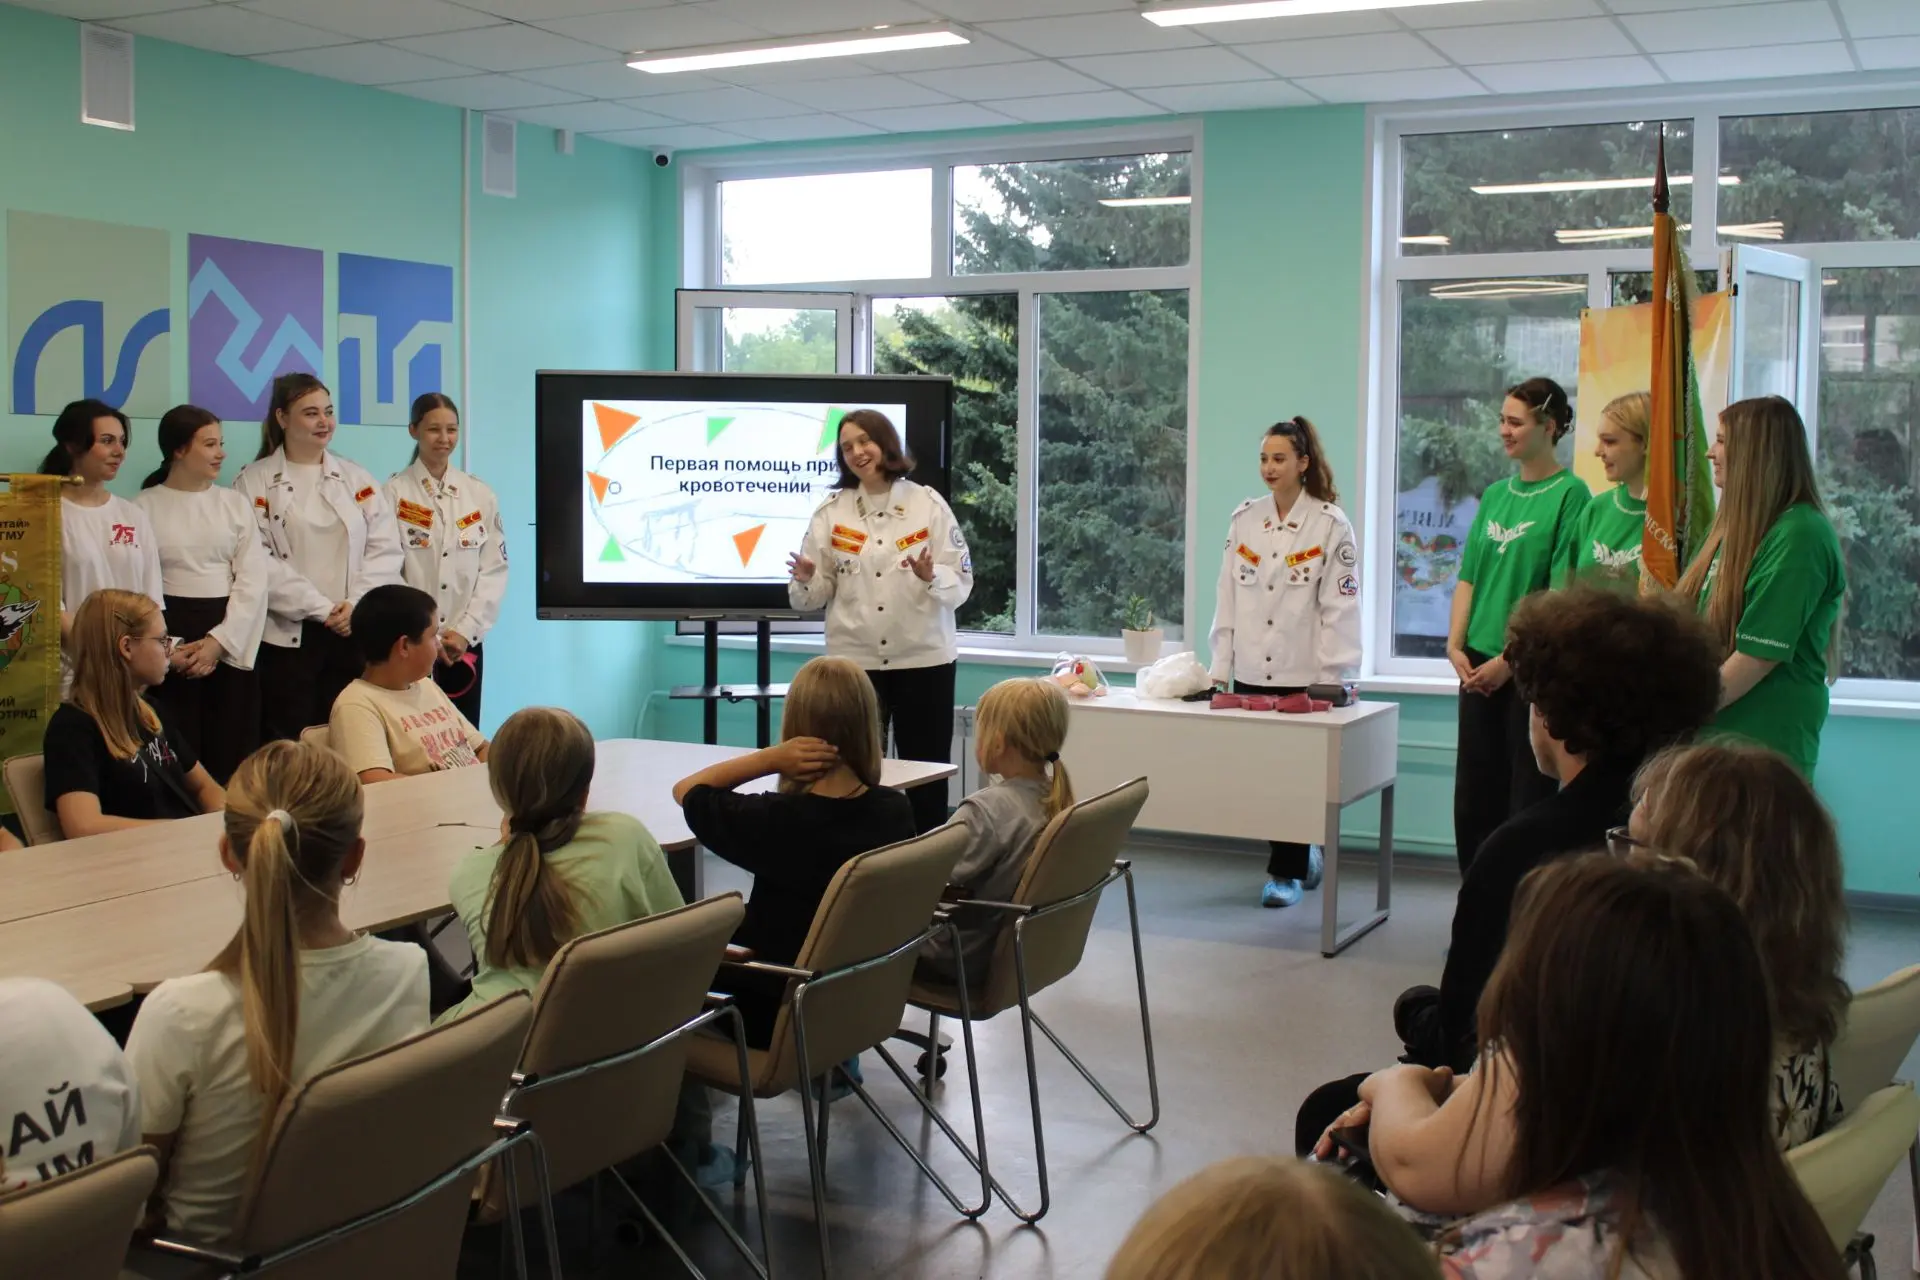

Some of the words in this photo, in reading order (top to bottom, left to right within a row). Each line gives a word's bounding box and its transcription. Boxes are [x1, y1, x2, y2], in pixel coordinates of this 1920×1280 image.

[650, 455, 719, 475] Первая
[724, 459, 801, 474] помощь
[806, 460, 838, 476] при
[679, 480, 811, 496] кровотечении
[0, 518, 30, 529] тай»
